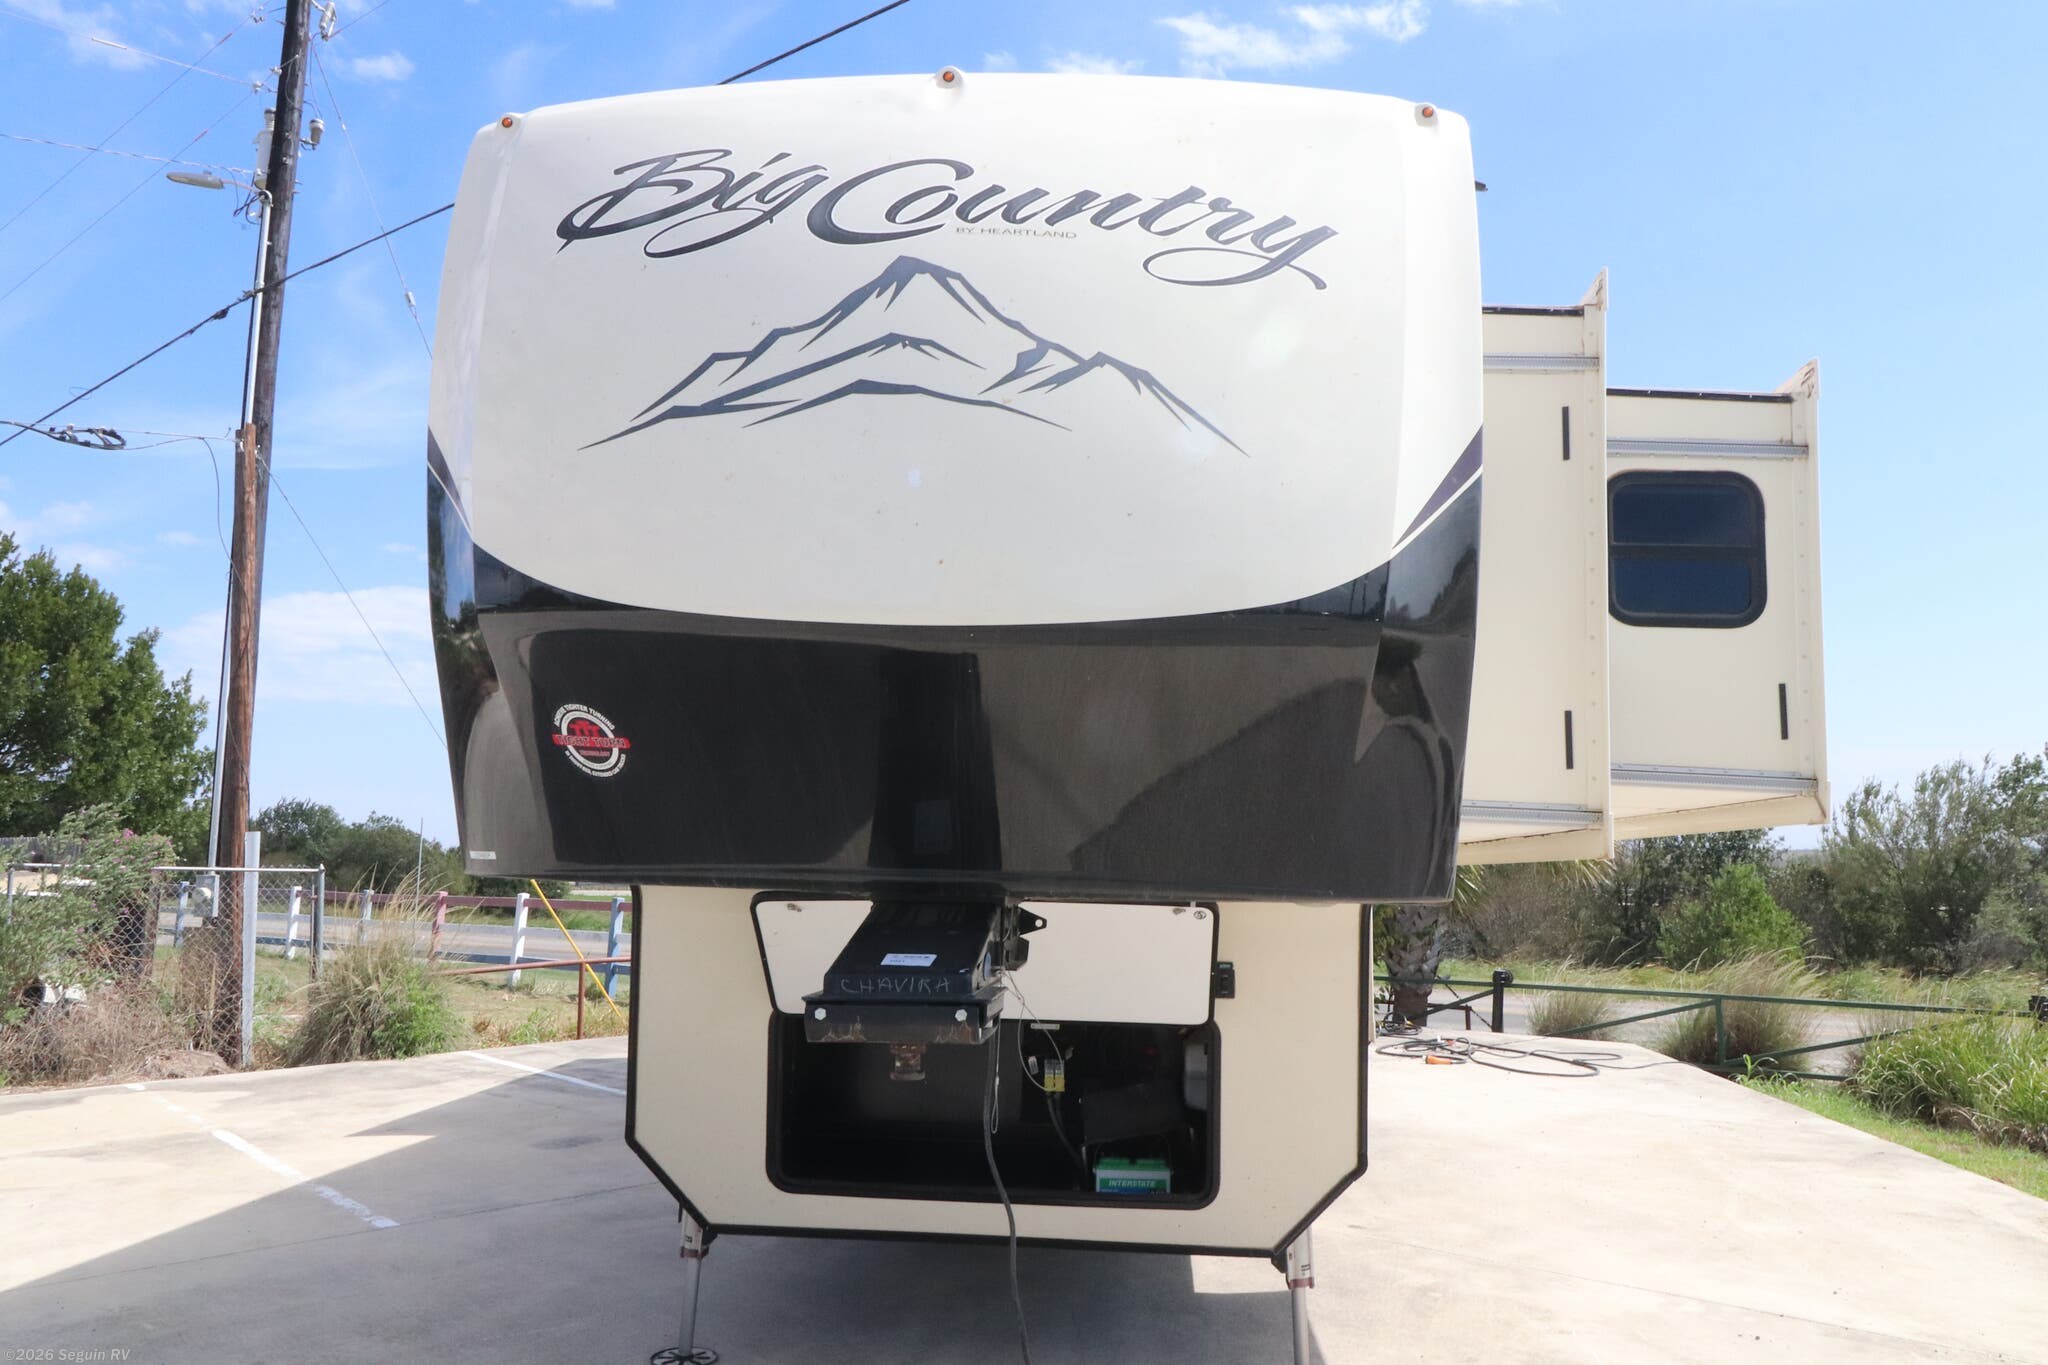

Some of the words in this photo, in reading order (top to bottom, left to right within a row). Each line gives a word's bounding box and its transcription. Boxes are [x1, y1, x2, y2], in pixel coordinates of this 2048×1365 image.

[556, 149, 829, 258] Big
[807, 158, 1338, 290] Country
[956, 226, 976, 234] BY
[980, 227, 1077, 240] HEARTLAND
[588, 707, 616, 731] TURNING
[557, 735, 590, 747] TIGHT
[591, 736, 627, 749] TURN
[840, 975, 951, 994] CHAVIRA
[1108, 1179, 1155, 1189] INTERSTATE
